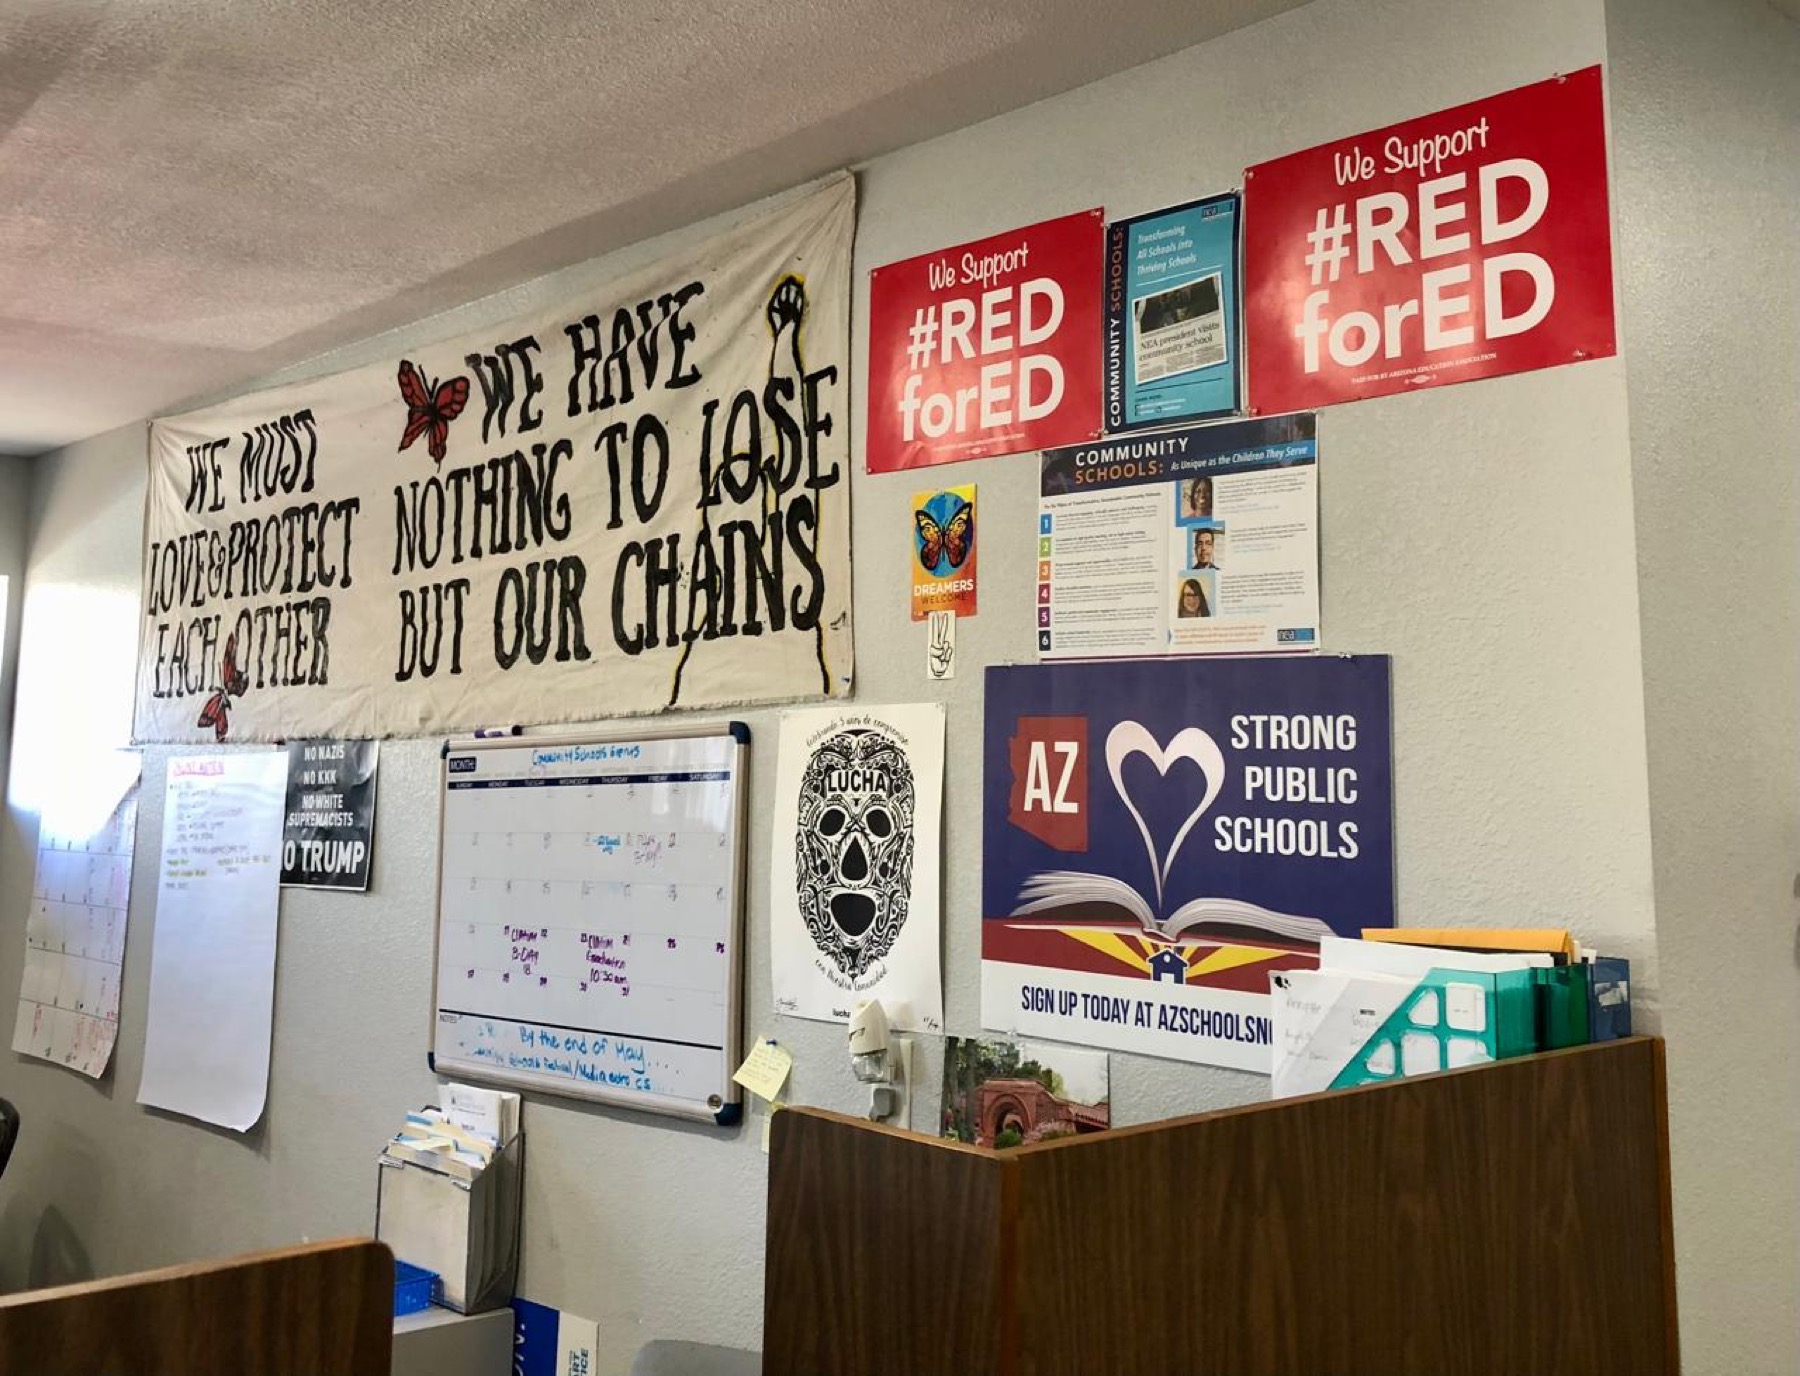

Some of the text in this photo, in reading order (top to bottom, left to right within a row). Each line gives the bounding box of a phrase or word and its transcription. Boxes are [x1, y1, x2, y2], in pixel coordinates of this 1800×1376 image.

[1334, 117, 1489, 186] We Support
[1137, 224, 1186, 245] Transforming
[1304, 157, 1550, 286] #RED
[928, 242, 1030, 292] We Support
[1137, 249, 1147, 260] All
[1148, 243, 1177, 259] Schools
[1168, 251, 1198, 271] Schools
[908, 277, 1065, 371] #RED
[1110, 227, 1124, 427] COMMUNITY SCHOOLS:
[1294, 252, 1555, 376] forED
[1140, 338, 1158, 350] NEA
[1186, 332, 1213, 348] school
[466, 281, 704, 444] WE HAVE
[900, 353, 1066, 442] forED
[184, 409, 316, 514] WE MUST
[1075, 437, 1190, 467] COMMUNITY
[1075, 444, 1308, 485] SCHOOLS: As Unique as the Children They Serve
[392, 365, 839, 575] NOTHING TO LOSE
[395, 495, 823, 681] BUT OUR CHAINS
[913, 579, 974, 597] DREAMERS
[922, 593, 967, 605] WELCOME
[1041, 588, 1048, 600] 4
[1041, 611, 1048, 623] 5
[152, 596, 330, 699] EACH OTHER
[1041, 635, 1049, 647] 6
[1231, 715, 1357, 751] STRONG
[304, 744, 345, 761] NO NAZIS
[303, 770, 337, 785] NO KKK
[827, 769, 887, 793] LUCHA
[1024, 741, 1079, 813] AZ
[1245, 766, 1359, 804] PUBLIC
[302, 793, 344, 809] NO WHITE
[287, 812, 354, 827] SUPREMACISTS
[1215, 816, 1359, 859] SCHOOLS
[300, 839, 365, 874] TRUMP
[1021, 985, 1055, 1014] SIGN
[1059, 990, 1079, 1017] UP
[1082, 993, 1131, 1025] TODAY
[1135, 1001, 1154, 1027] AT
[519, 1026, 534, 1048] By
[539, 1029, 559, 1050] the
[564, 1035, 587, 1055] end
[593, 1037, 608, 1056] of
